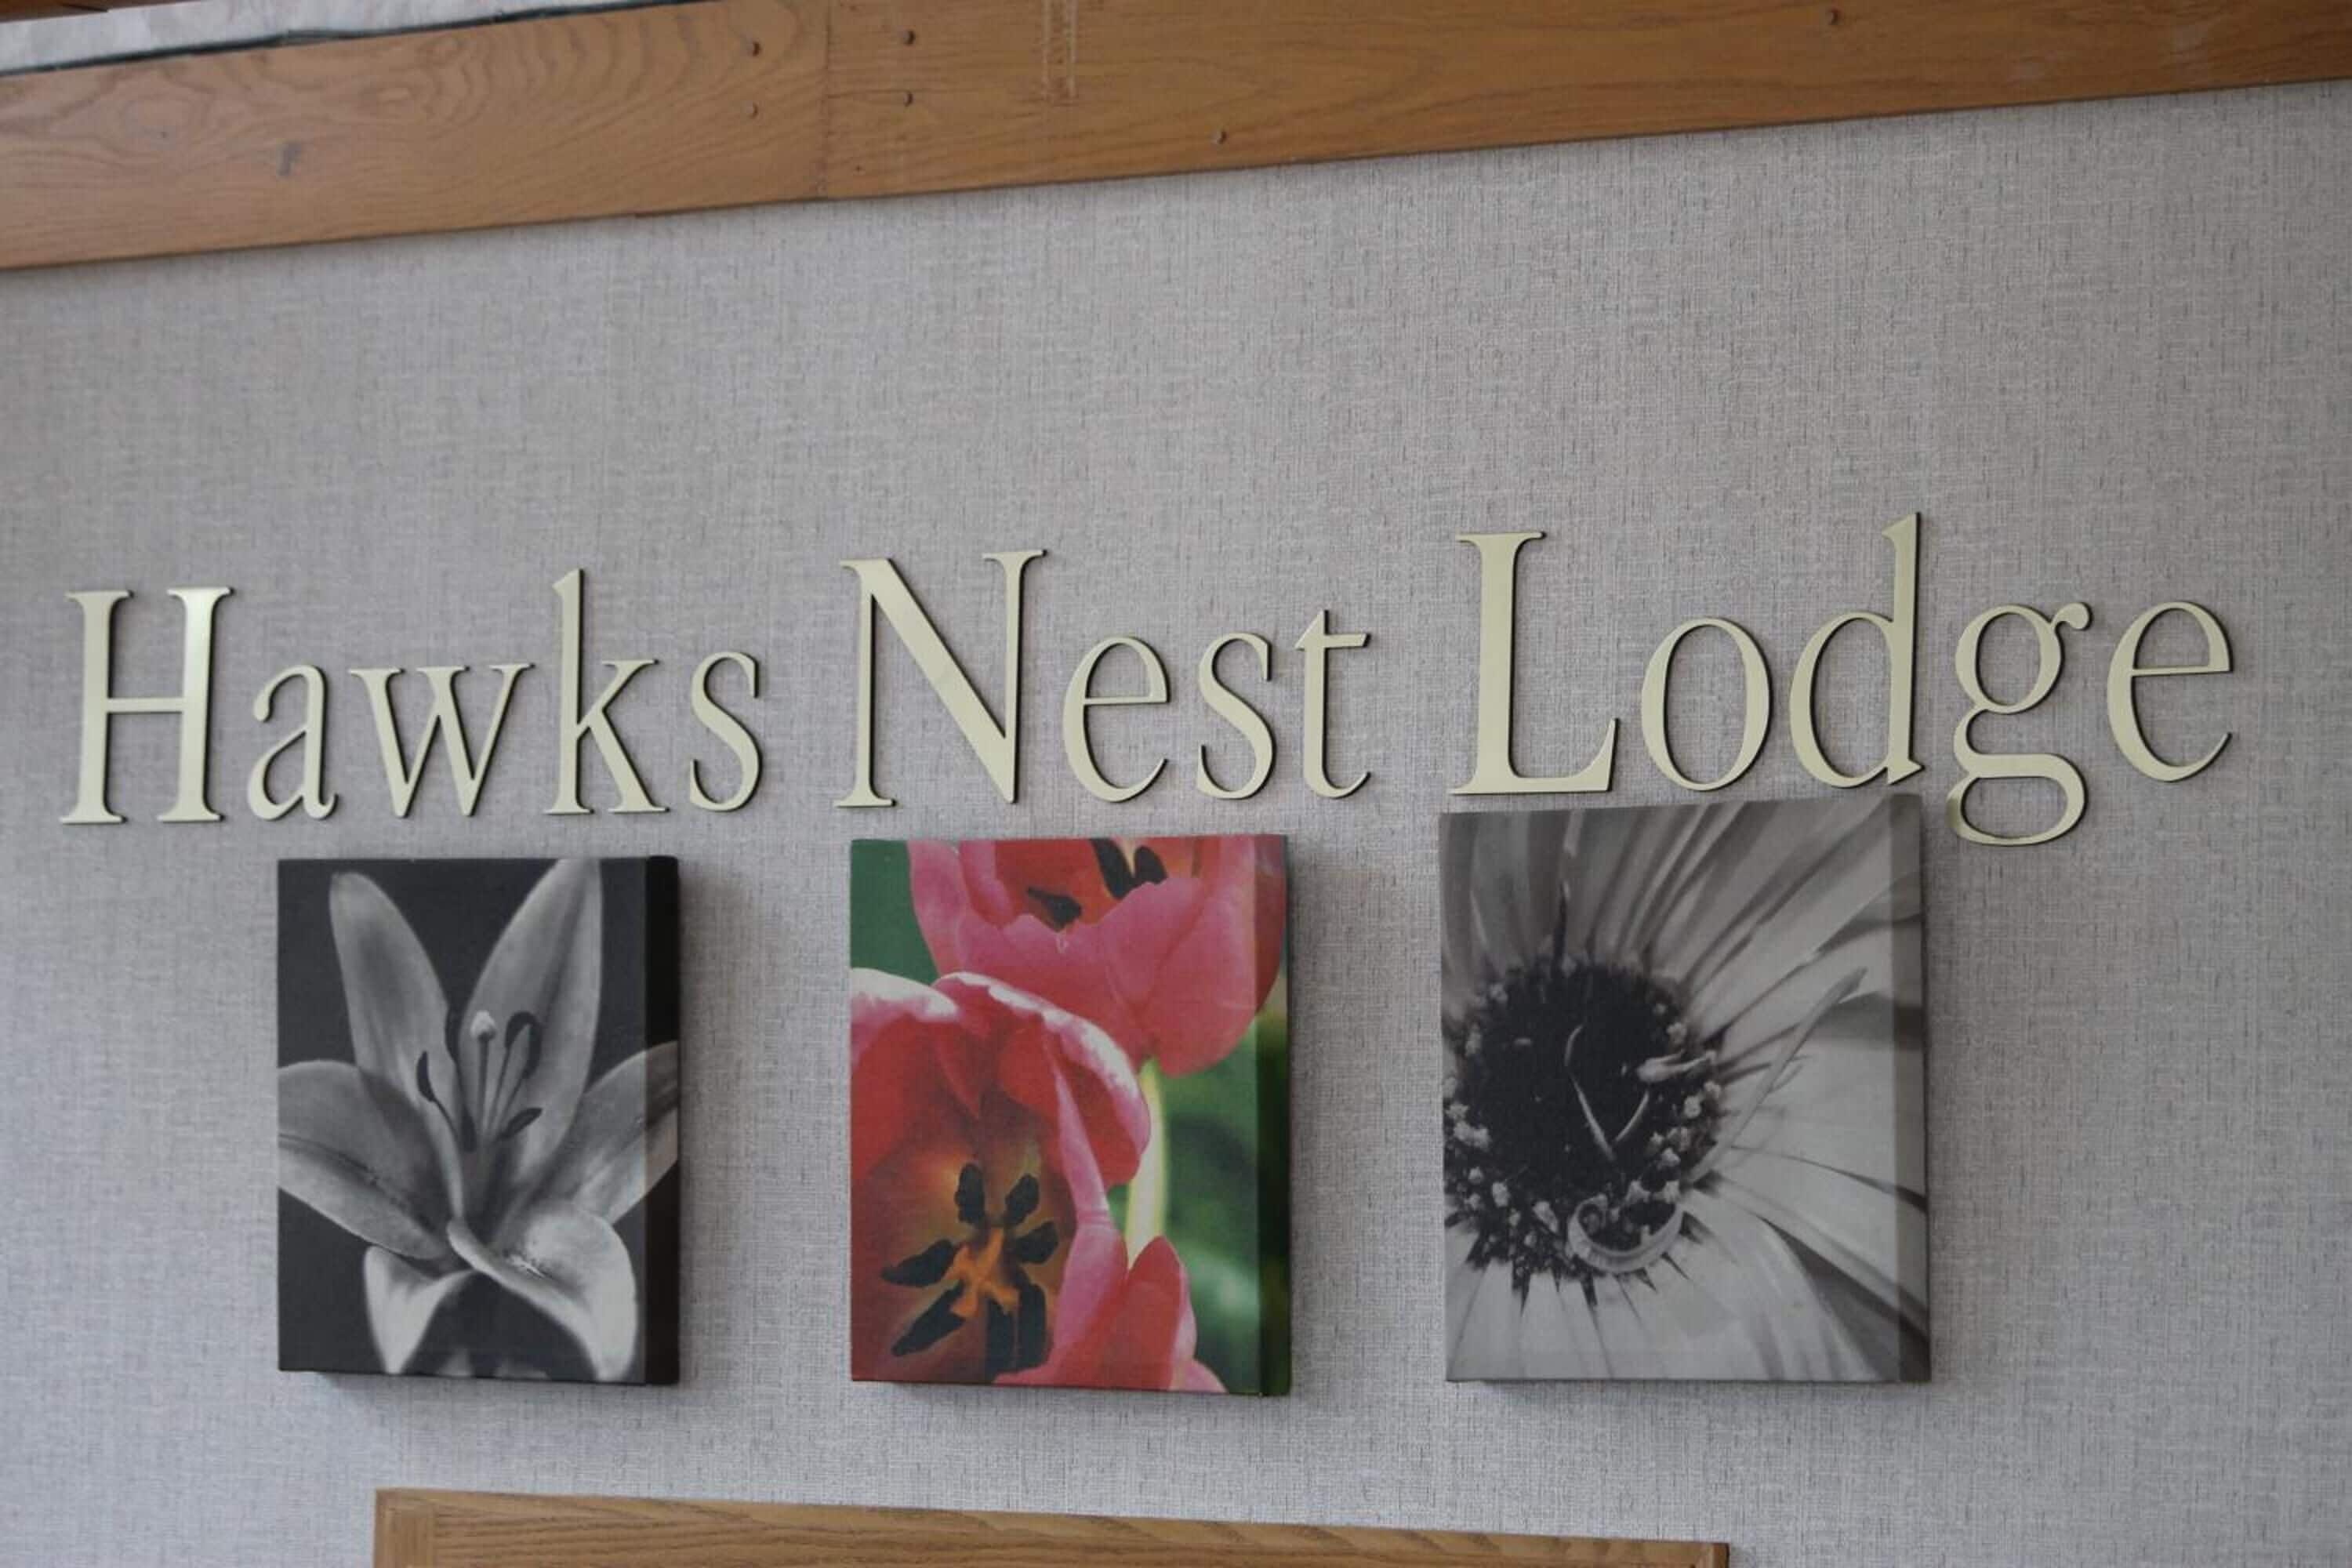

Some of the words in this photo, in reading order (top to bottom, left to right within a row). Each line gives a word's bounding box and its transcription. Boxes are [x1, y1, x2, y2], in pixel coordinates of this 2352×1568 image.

[60, 568, 767, 825] Hawks
[833, 548, 1372, 808] Nest
[1448, 513, 2236, 847] Lodge
